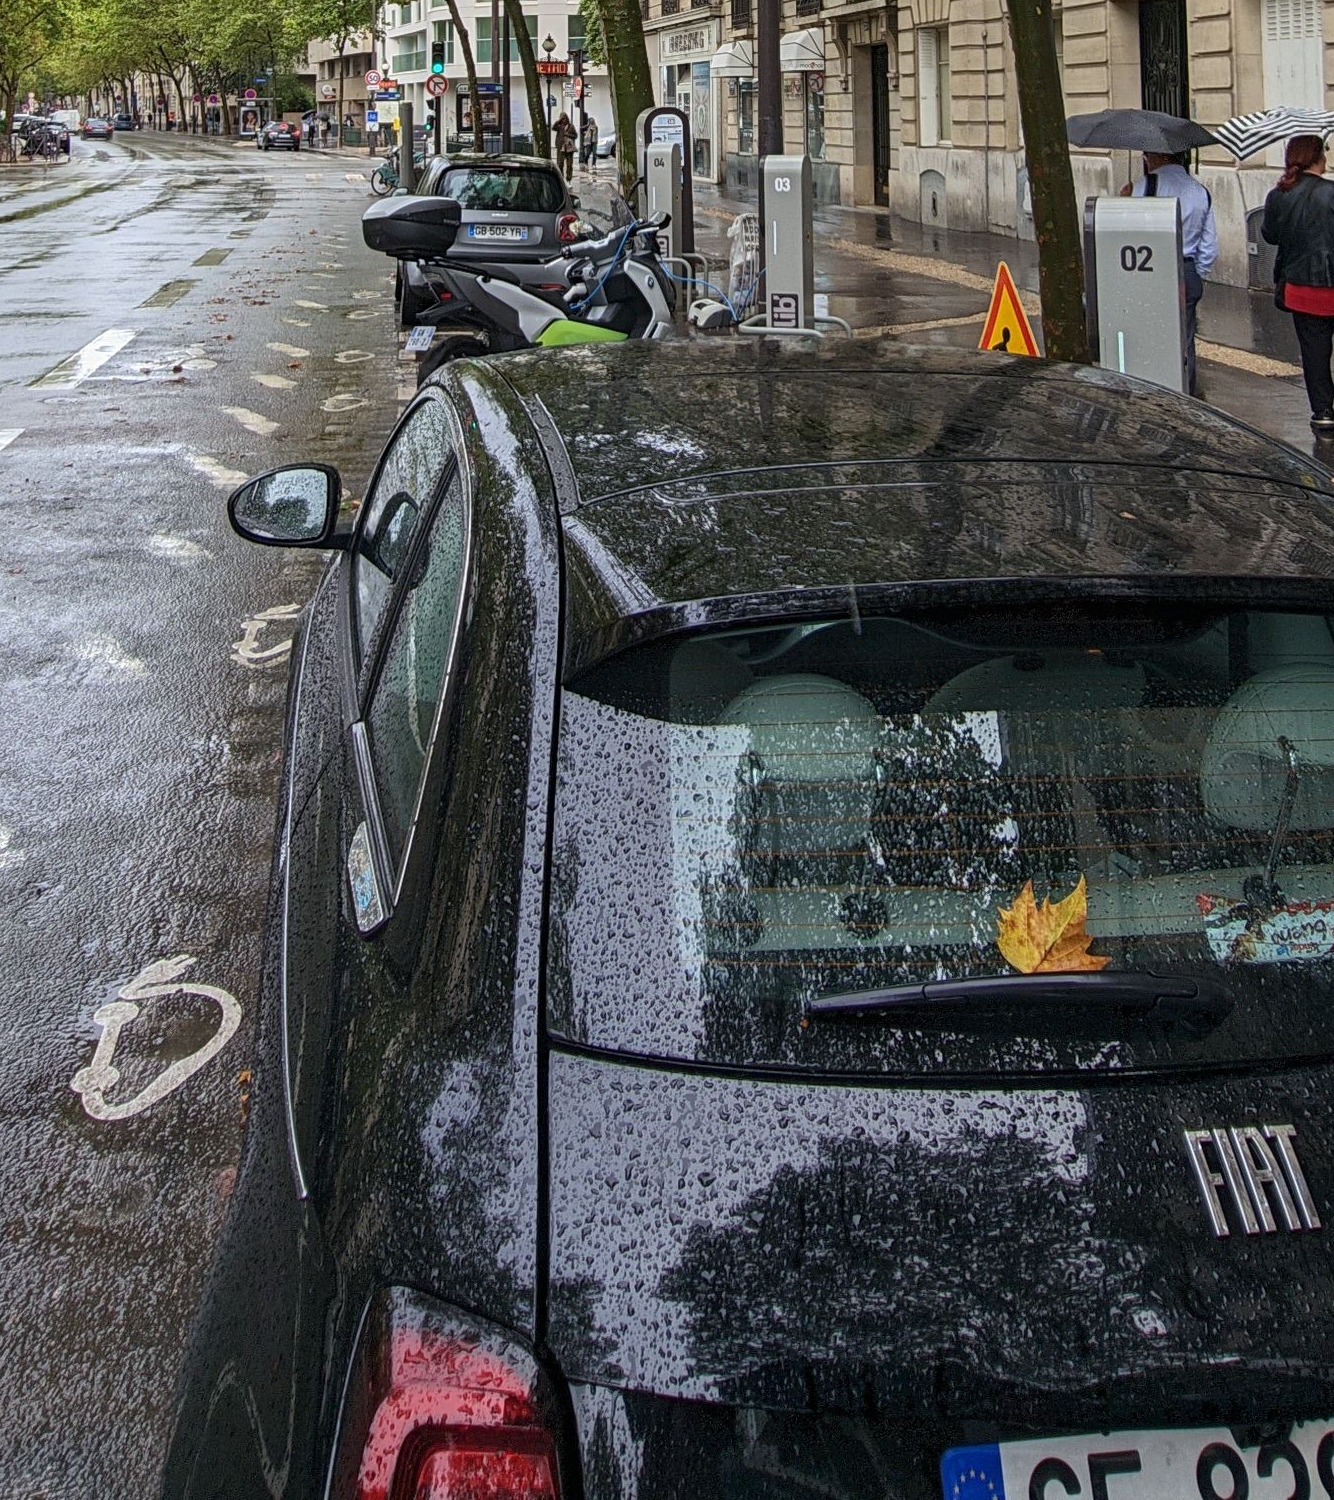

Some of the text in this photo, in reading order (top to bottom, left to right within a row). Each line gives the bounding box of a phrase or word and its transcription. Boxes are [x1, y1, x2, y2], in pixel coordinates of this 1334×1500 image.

[653, 157, 665, 168] 04
[774, 177, 791, 192] 03
[1120, 245, 1154, 272] 02
[1184, 1124, 1322, 1238] FIAT
